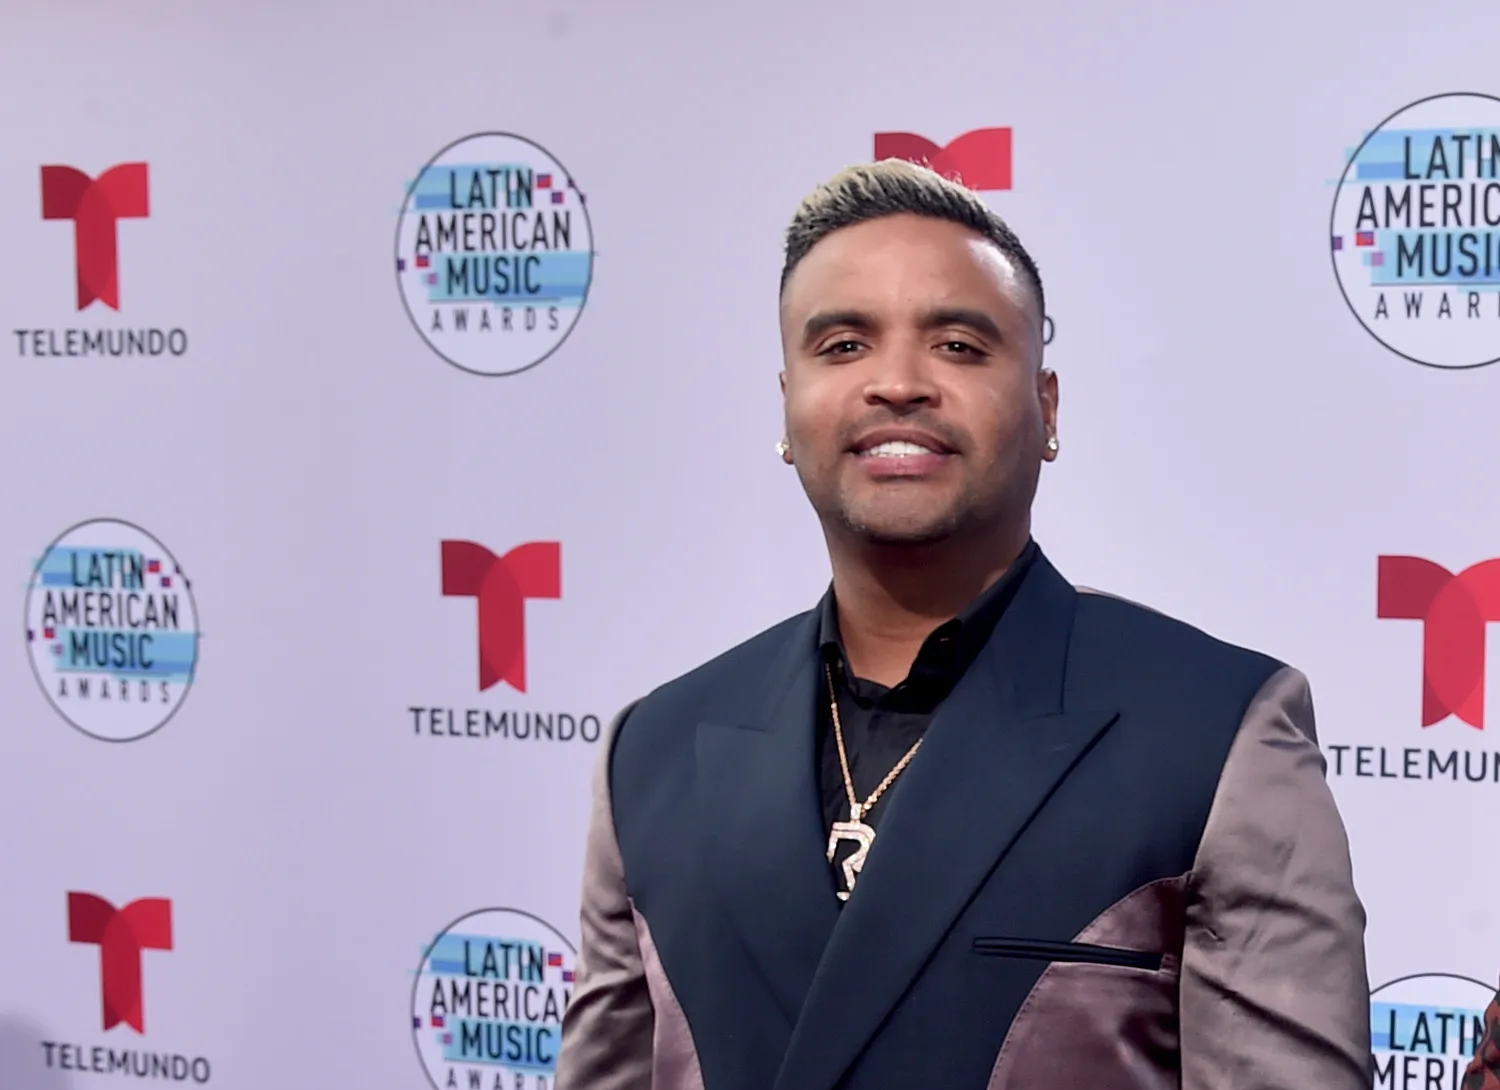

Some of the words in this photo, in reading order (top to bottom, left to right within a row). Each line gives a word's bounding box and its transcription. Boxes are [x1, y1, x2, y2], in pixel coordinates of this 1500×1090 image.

[450, 169, 533, 210] LATIN
[415, 211, 570, 254] AMERICAN
[447, 255, 541, 296] MUSIC
[432, 306, 559, 331] AWARDS
[14, 328, 187, 357] TELEMUNDO
[71, 552, 146, 589] LATIN
[42, 591, 178, 629] AMERICAN
[70, 631, 154, 670] MUSIC
[59, 678, 169, 703] AWARDS
[408, 707, 600, 743] TELEMUNDO
[464, 941, 544, 982] LATIN
[40, 1040, 210, 1084] TELEMUNDO
[461, 1021, 552, 1065] MUSIC
